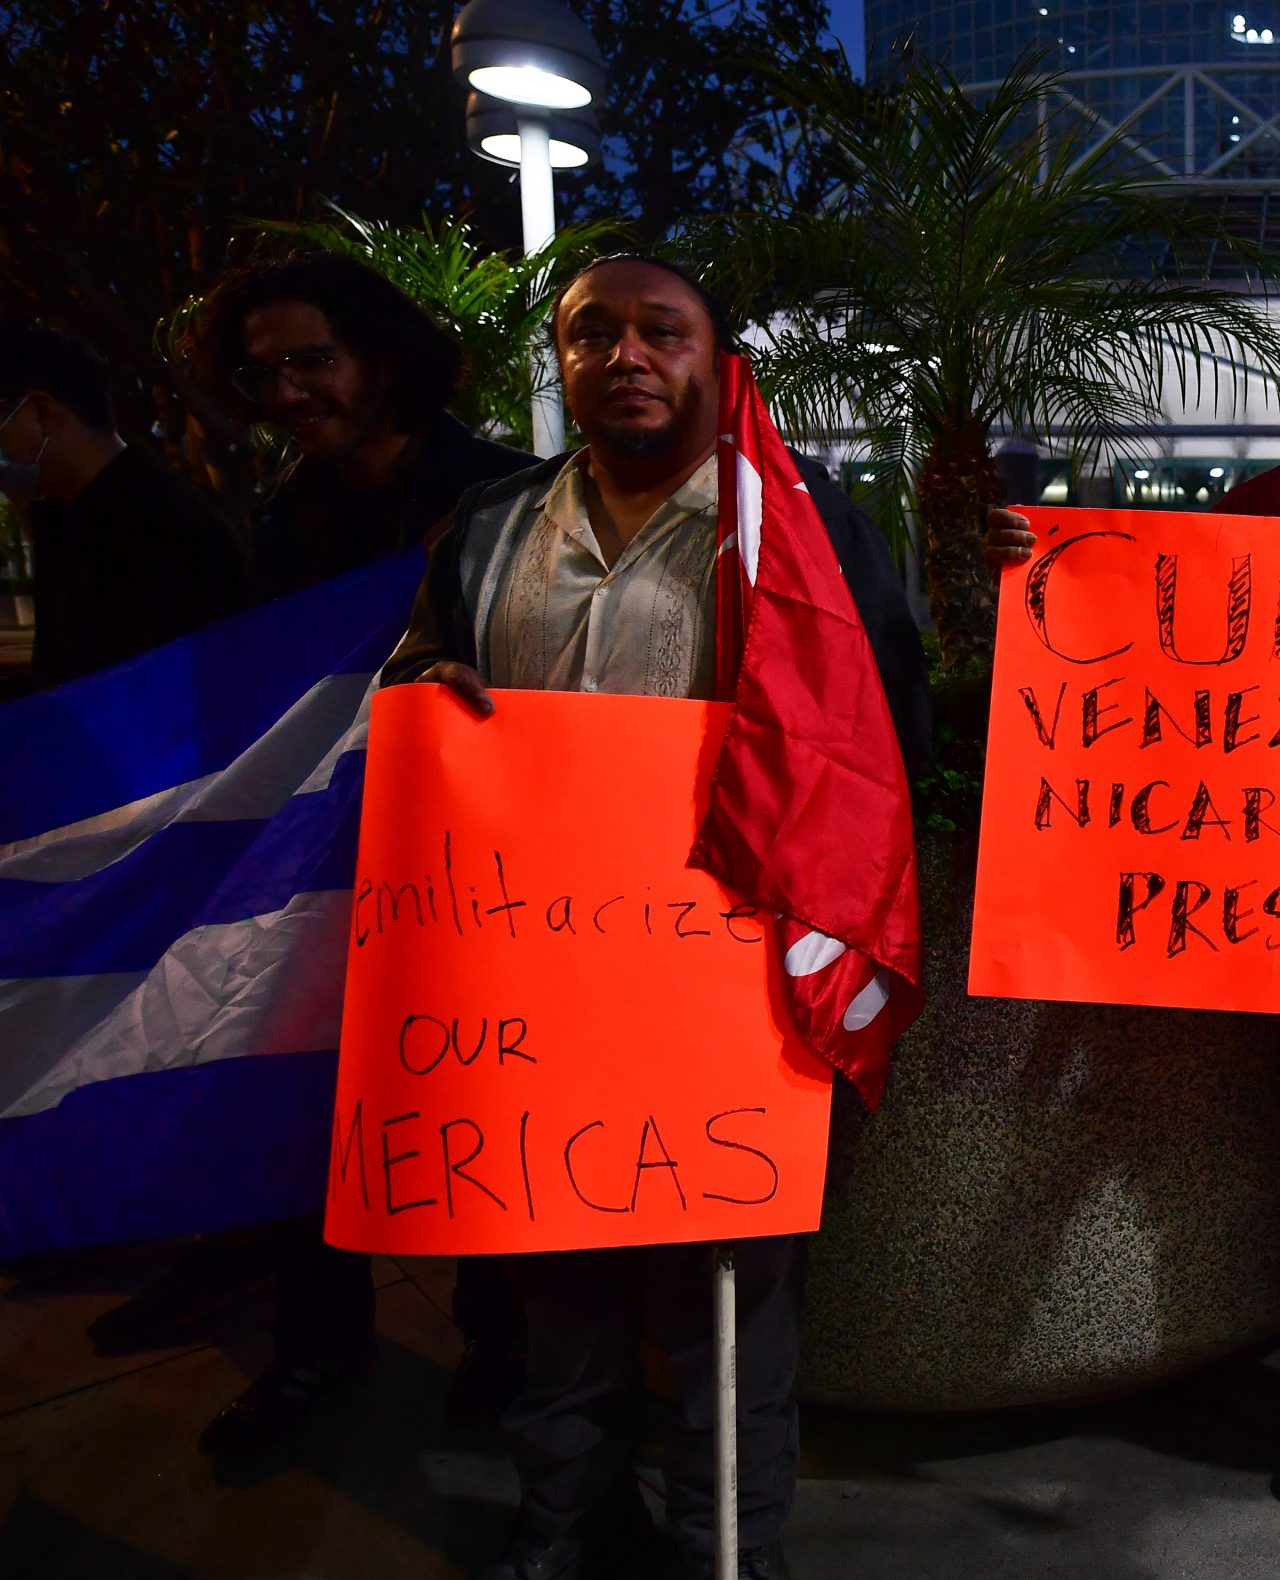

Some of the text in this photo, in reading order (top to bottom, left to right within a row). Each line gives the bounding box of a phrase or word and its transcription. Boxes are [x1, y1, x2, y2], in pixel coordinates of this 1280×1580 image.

[354, 831, 764, 948] emilitarize
[400, 1014, 537, 1075] OUR
[333, 1099, 779, 1222] MERICAS
